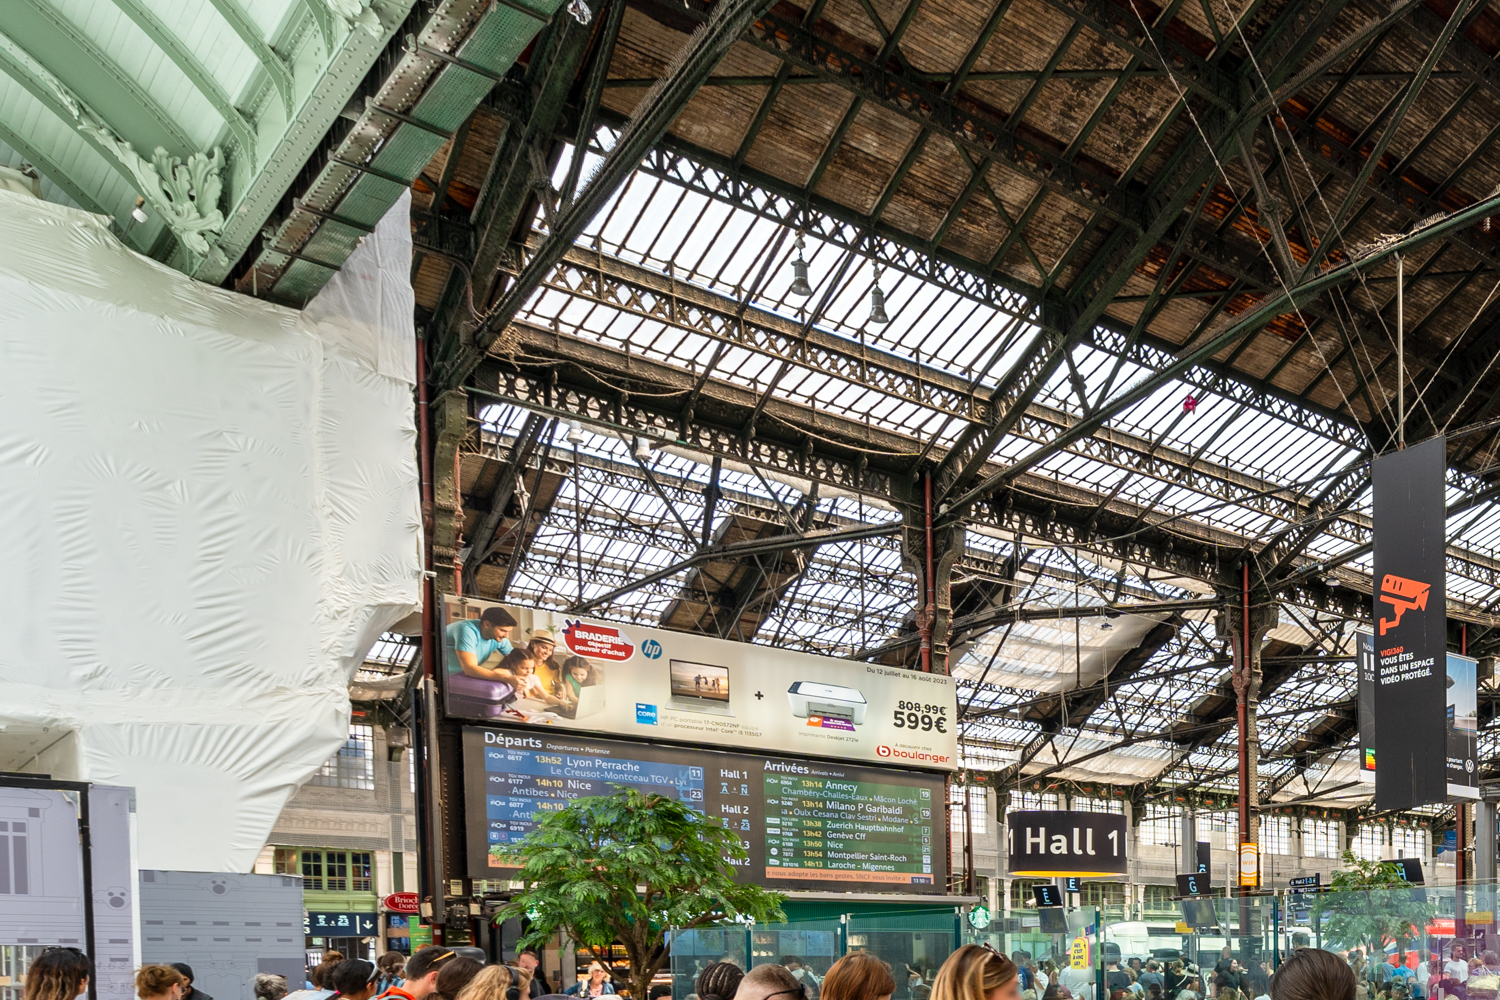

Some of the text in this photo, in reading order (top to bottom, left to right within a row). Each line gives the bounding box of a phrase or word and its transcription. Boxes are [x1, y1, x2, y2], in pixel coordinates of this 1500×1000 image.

[1380, 645, 1404, 658] VIGI360
[1380, 652, 1414, 666] VOUS ÊTES
[1380, 657, 1435, 676] DANS UN ESPACE
[884, 669, 947, 685] juillet 2023
[1380, 666, 1432, 686] VIDÉO PROTÉGÉ.
[898, 700, 947, 716] 808,99€
[893, 710, 948, 734] 599€
[484, 731, 543, 749] Départs
[546, 743, 611, 756] Departures Partenze
[893, 748, 950, 764] boulanger
[535, 755, 563, 765] 13h52
[566, 757, 592, 769] Lyon
[595, 760, 640, 772] Perrache
[763, 760, 809, 775] Arrivées
[550, 766, 668, 784] Le Creusot-Montceau TGV
[720, 769, 748, 779] Hall 1
[535, 778, 563, 788] 14h10
[567, 780, 592, 791] Nice
[801, 780, 858, 793] 13h14 Annecy
[511, 787, 578, 799] Antibes Nice
[782, 786, 868, 801] Chambéry-Challes-Eaux
[898, 797, 918, 806] Loché
[536, 802, 564, 811] 14h10
[721, 805, 749, 815] Hall 2
[802, 800, 903, 815] 13h14 Milano P Garibaldi
[793, 808, 909, 824] Oulx Cesana Clav Sestri Modane
[802, 820, 904, 833] 13h38 Zuerich Hauptbahnhof
[803, 830, 867, 840] 13h42 Genève Cff
[1026, 827, 1118, 856] Hall 1
[803, 840, 844, 849] 13h50 Nice
[803, 850, 907, 862] 13h54 Montpellier Saint-Roch
[803, 860, 895, 872] 14h13 Laroche Migennes
[787, 870, 808, 878] adopte
[1189, 881, 1198, 893] G
[303, 917, 310, 925] 2
[303, 926, 311, 934] 3
